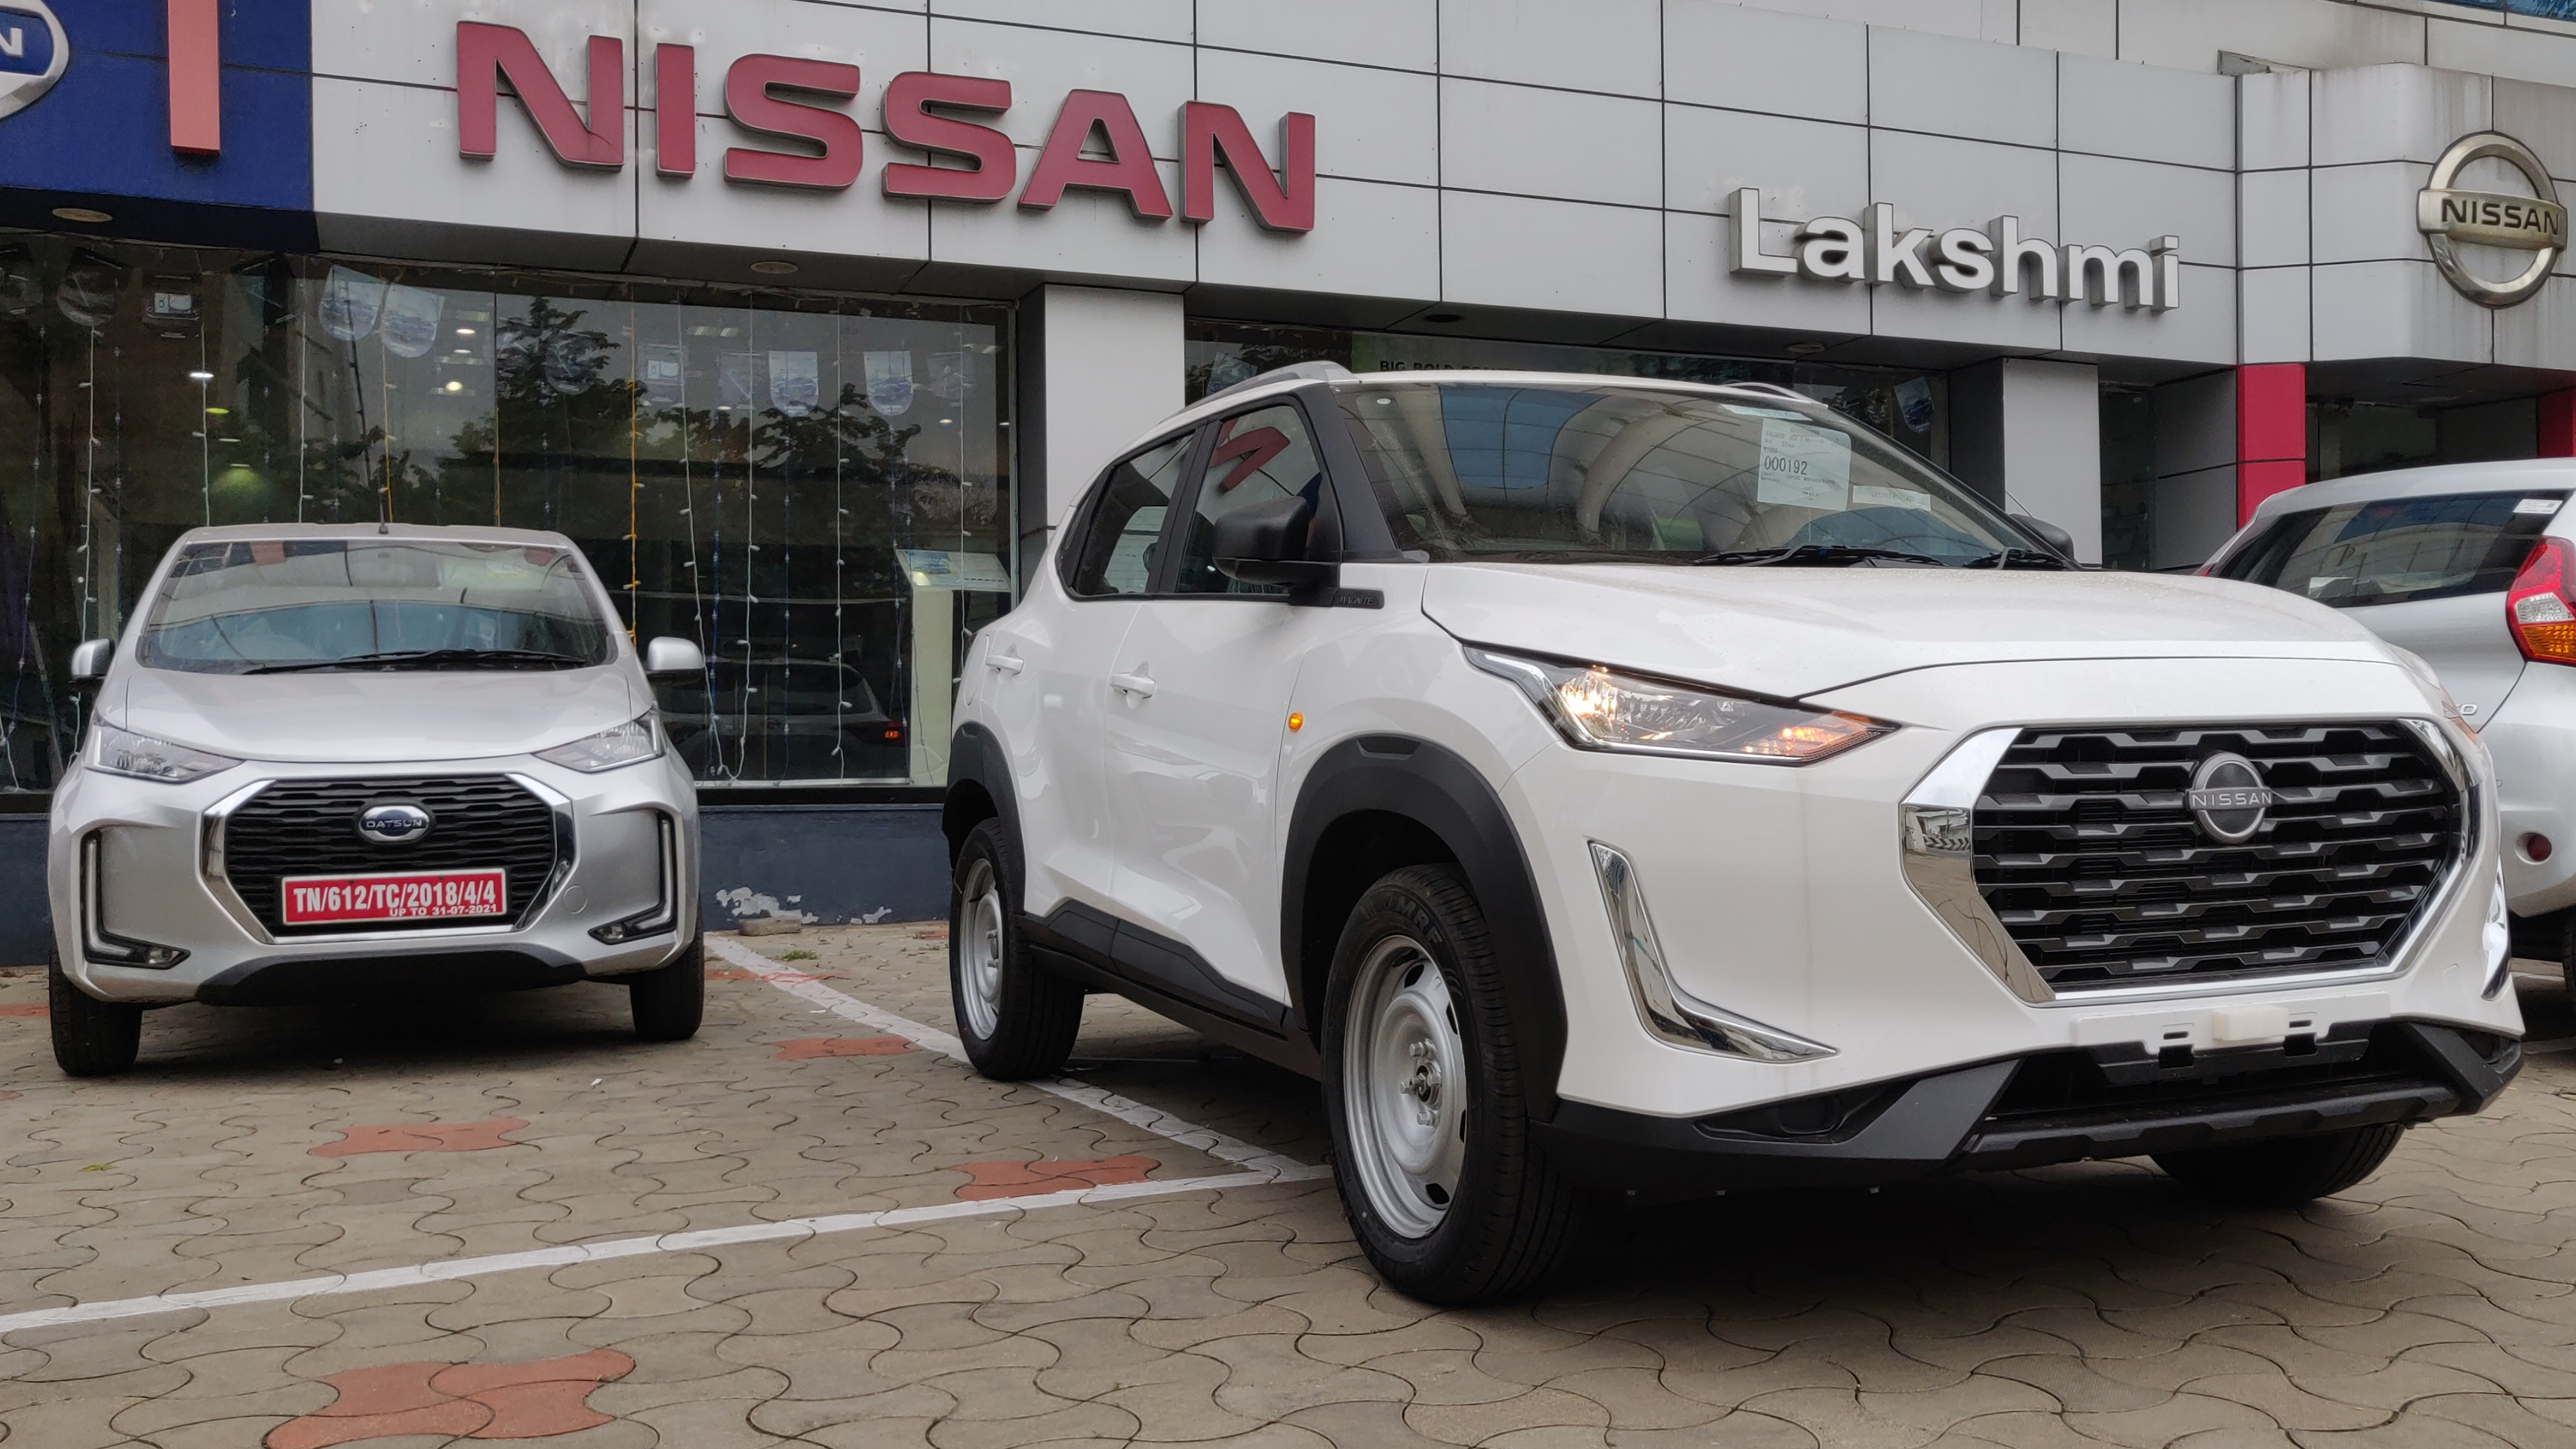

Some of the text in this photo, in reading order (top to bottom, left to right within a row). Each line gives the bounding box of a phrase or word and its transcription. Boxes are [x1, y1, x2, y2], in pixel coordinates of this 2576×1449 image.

[456, 20, 1316, 235] NISSAN
[2442, 198, 2559, 235] NISSAN
[1729, 187, 2180, 312] Lakshmi
[1380, 360, 1405, 371] BIG
[1764, 455, 1808, 475] 000192
[2192, 792, 2272, 808] NISSAN
[366, 819, 423, 829] DATSUN
[294, 880, 496, 913] TN/612/TC/2018/4/4
[389, 903, 497, 918] UP TO 31-07-2021
